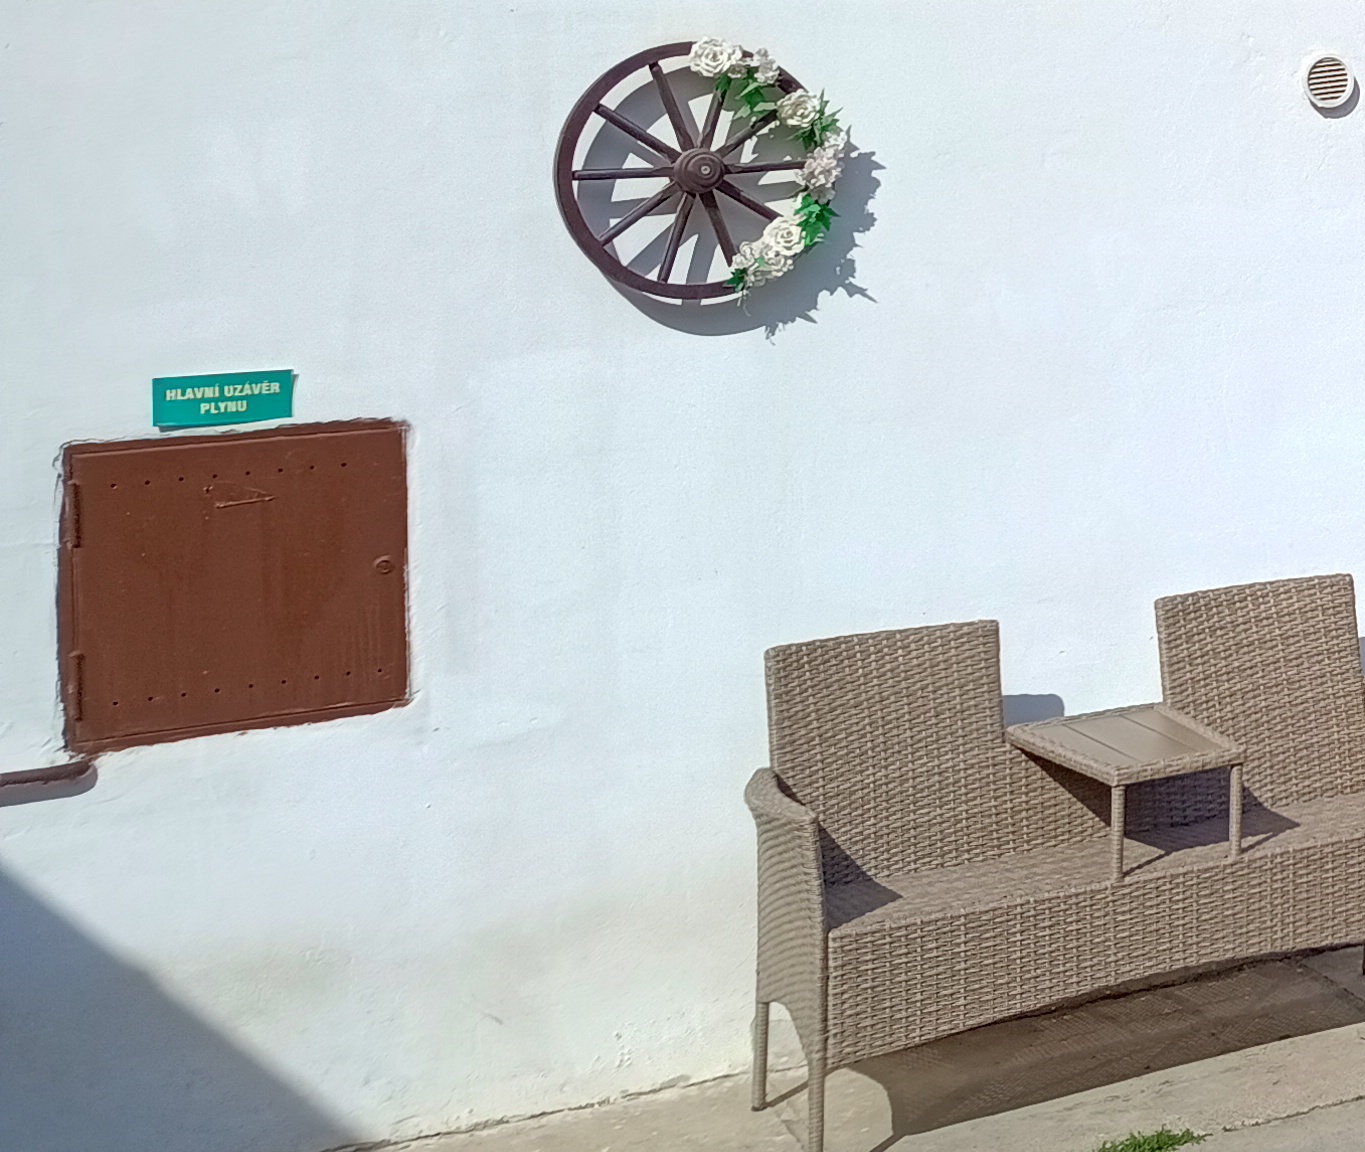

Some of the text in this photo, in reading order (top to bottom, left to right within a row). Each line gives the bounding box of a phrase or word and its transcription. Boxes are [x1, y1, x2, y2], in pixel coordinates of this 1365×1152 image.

[165, 380, 281, 401] HLAVNÍ UZÁVĚR
[200, 400, 248, 415] PLYNU
